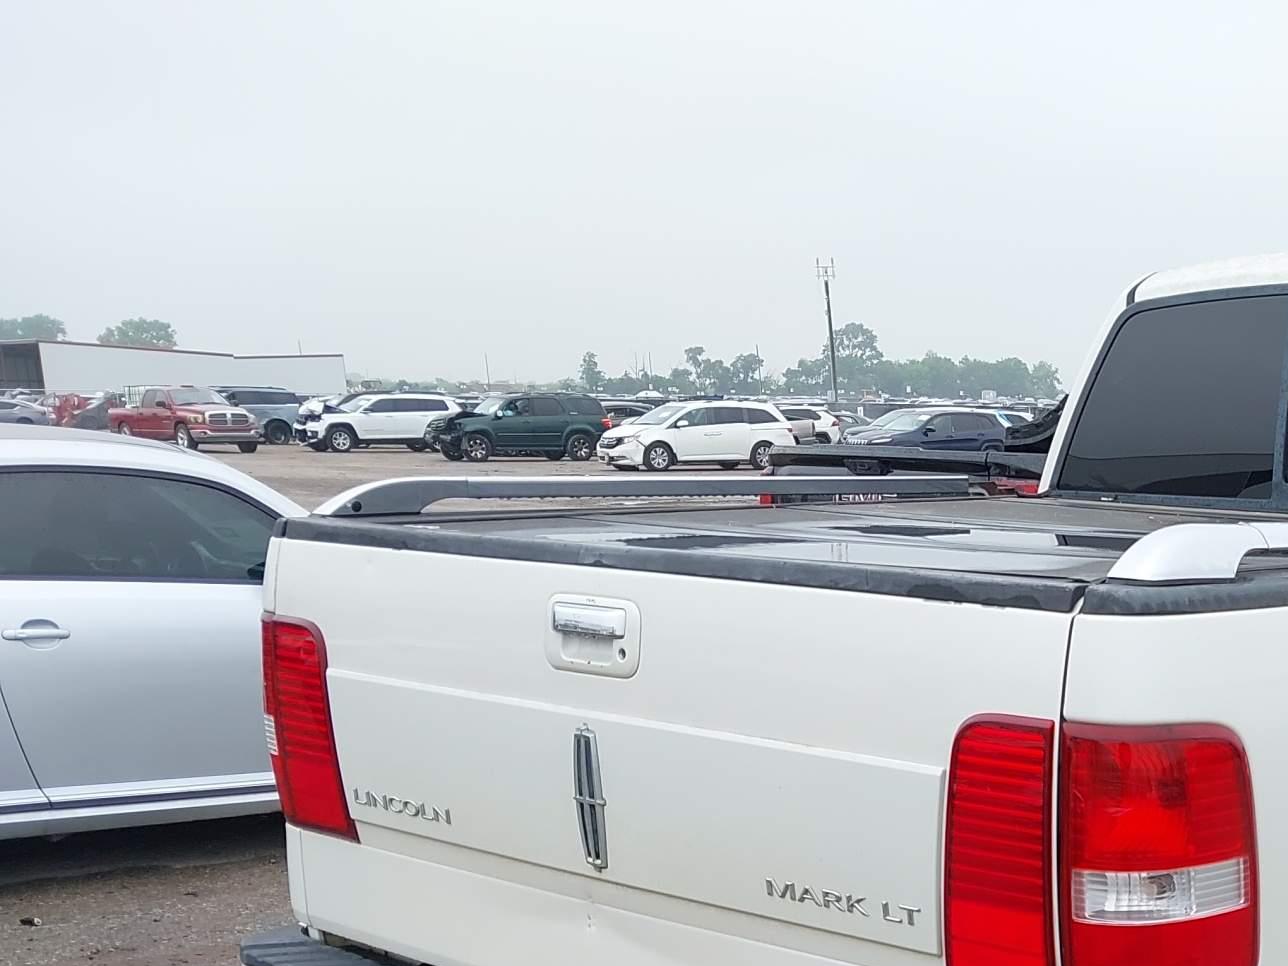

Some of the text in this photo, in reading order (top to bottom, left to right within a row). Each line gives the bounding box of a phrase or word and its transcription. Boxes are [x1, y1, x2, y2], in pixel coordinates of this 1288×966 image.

[352, 787, 451, 825] LINCOLN
[765, 877, 921, 926] MARK LT
